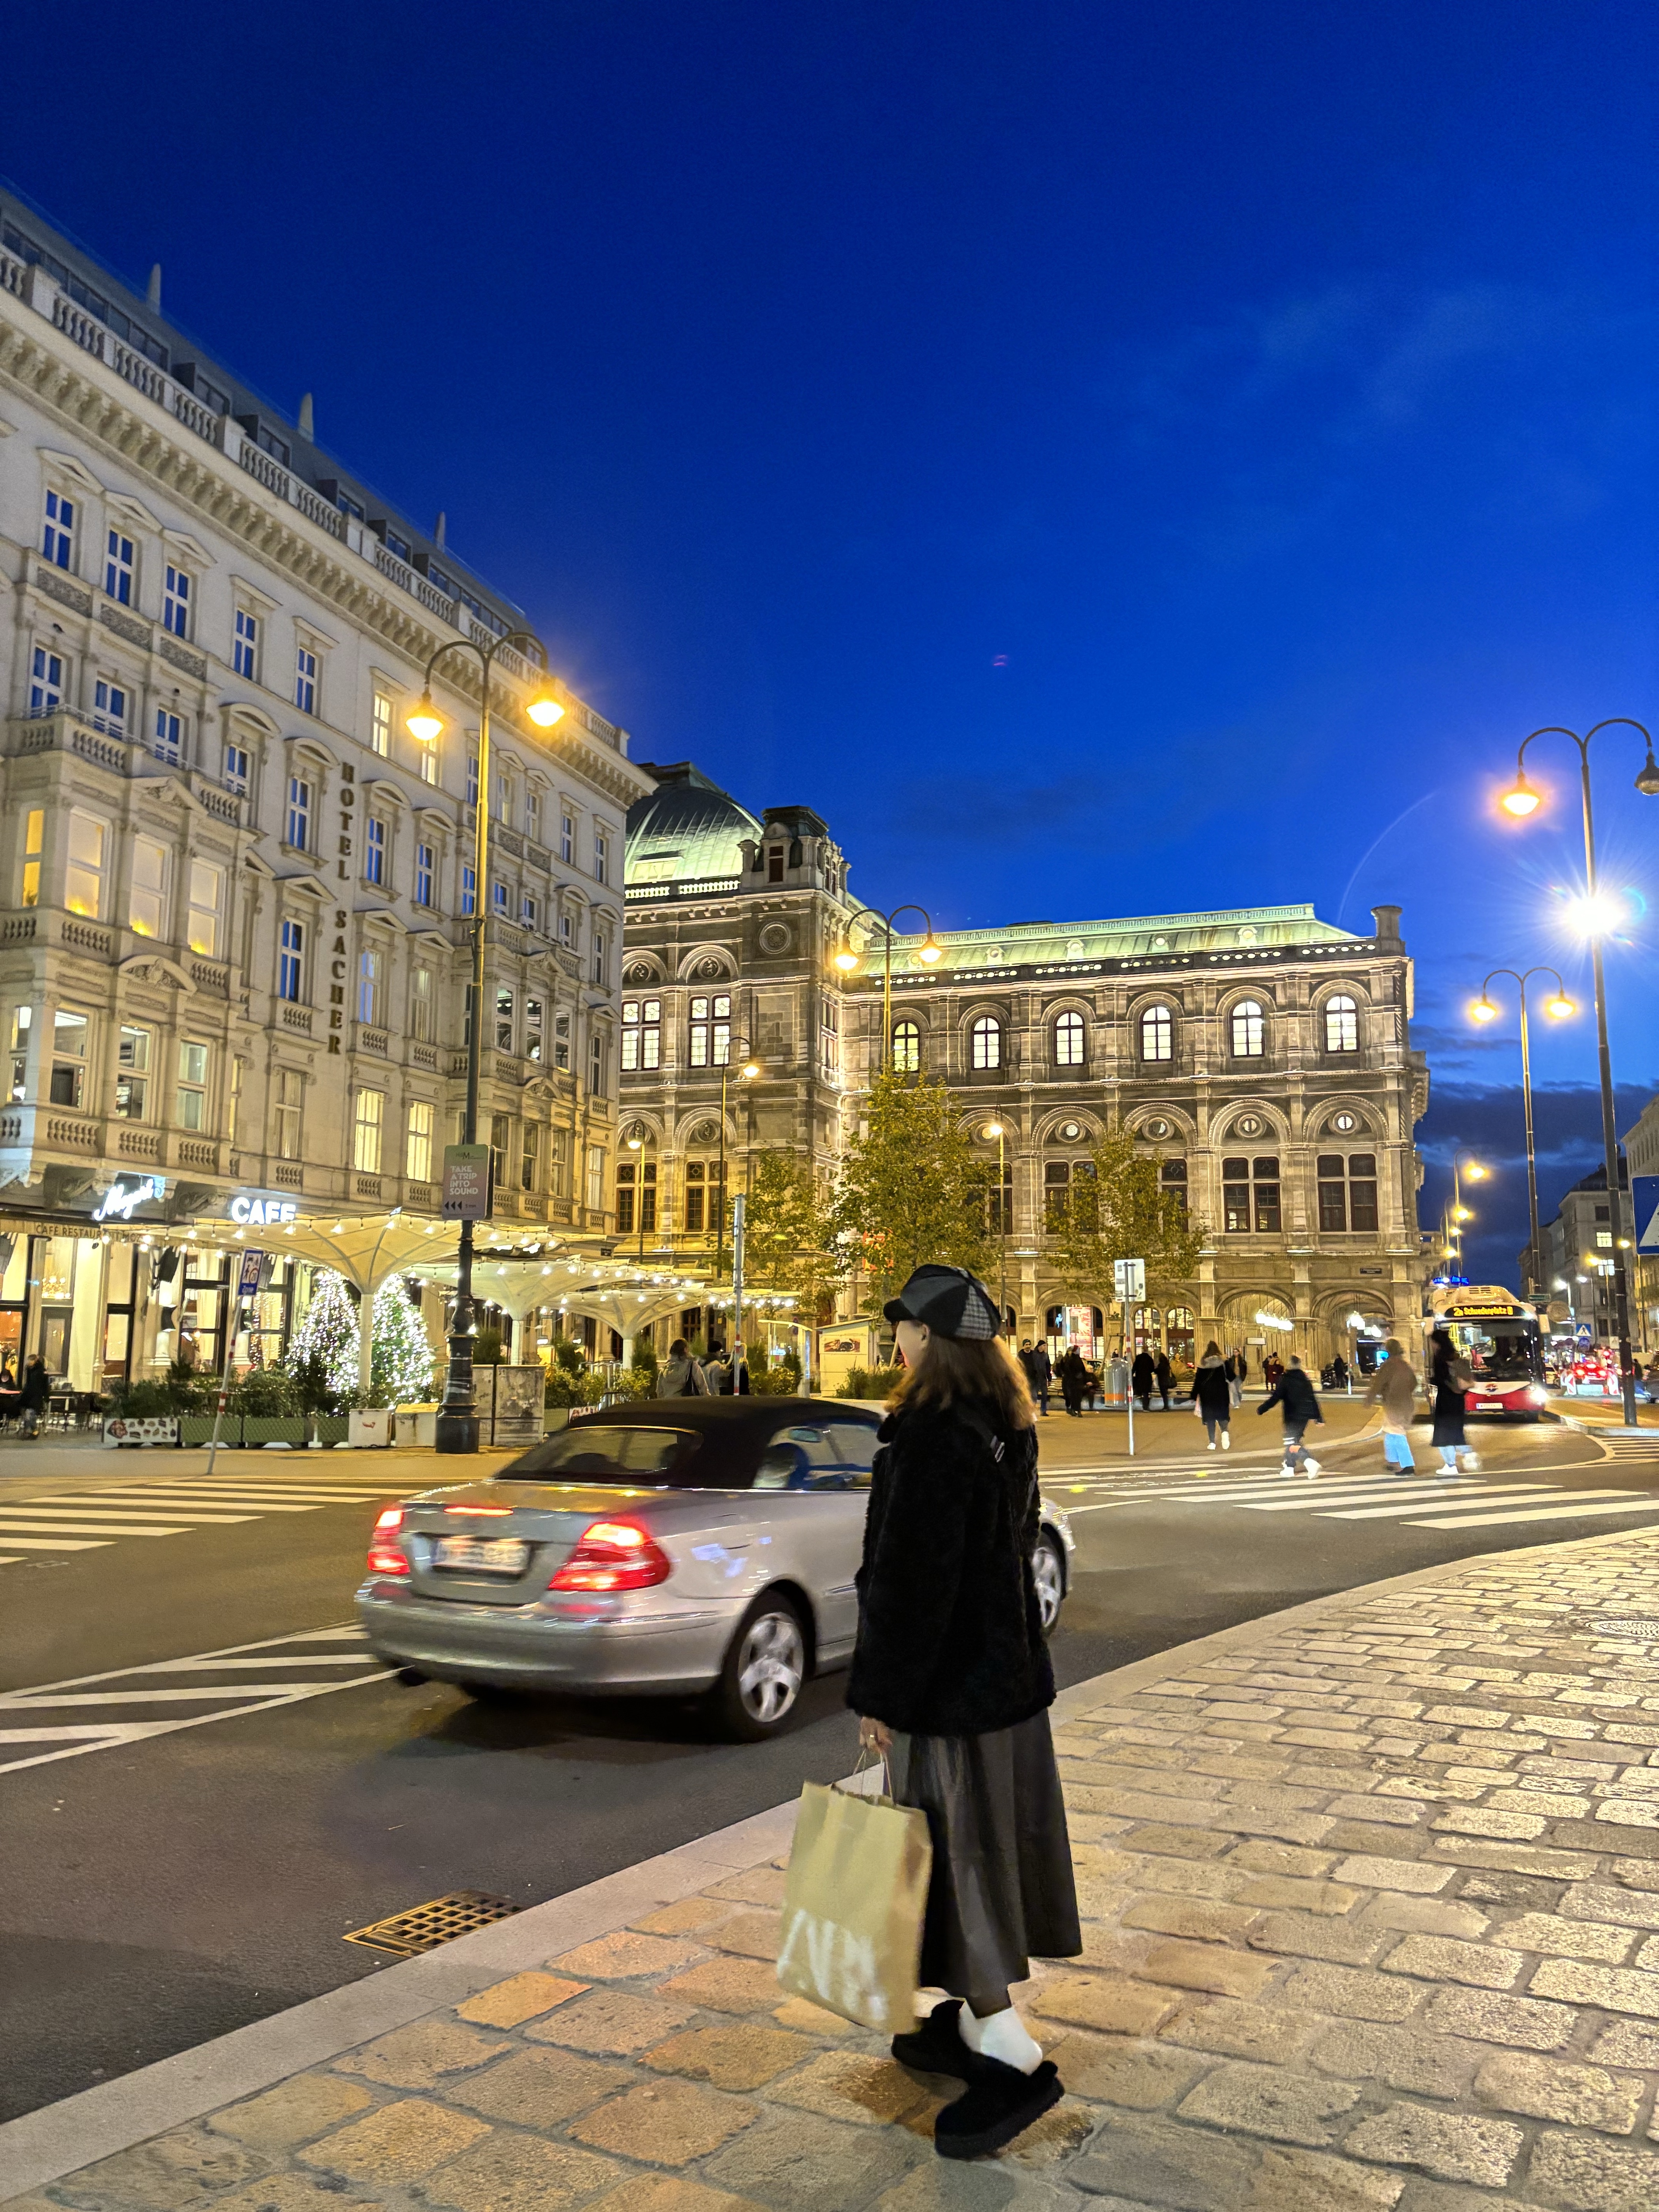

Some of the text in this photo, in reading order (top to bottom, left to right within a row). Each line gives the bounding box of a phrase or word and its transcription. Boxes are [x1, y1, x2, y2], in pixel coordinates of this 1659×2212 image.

[328, 762, 355, 1055] HOTEL SACHER
[450, 1187, 478, 1195] SOUND
